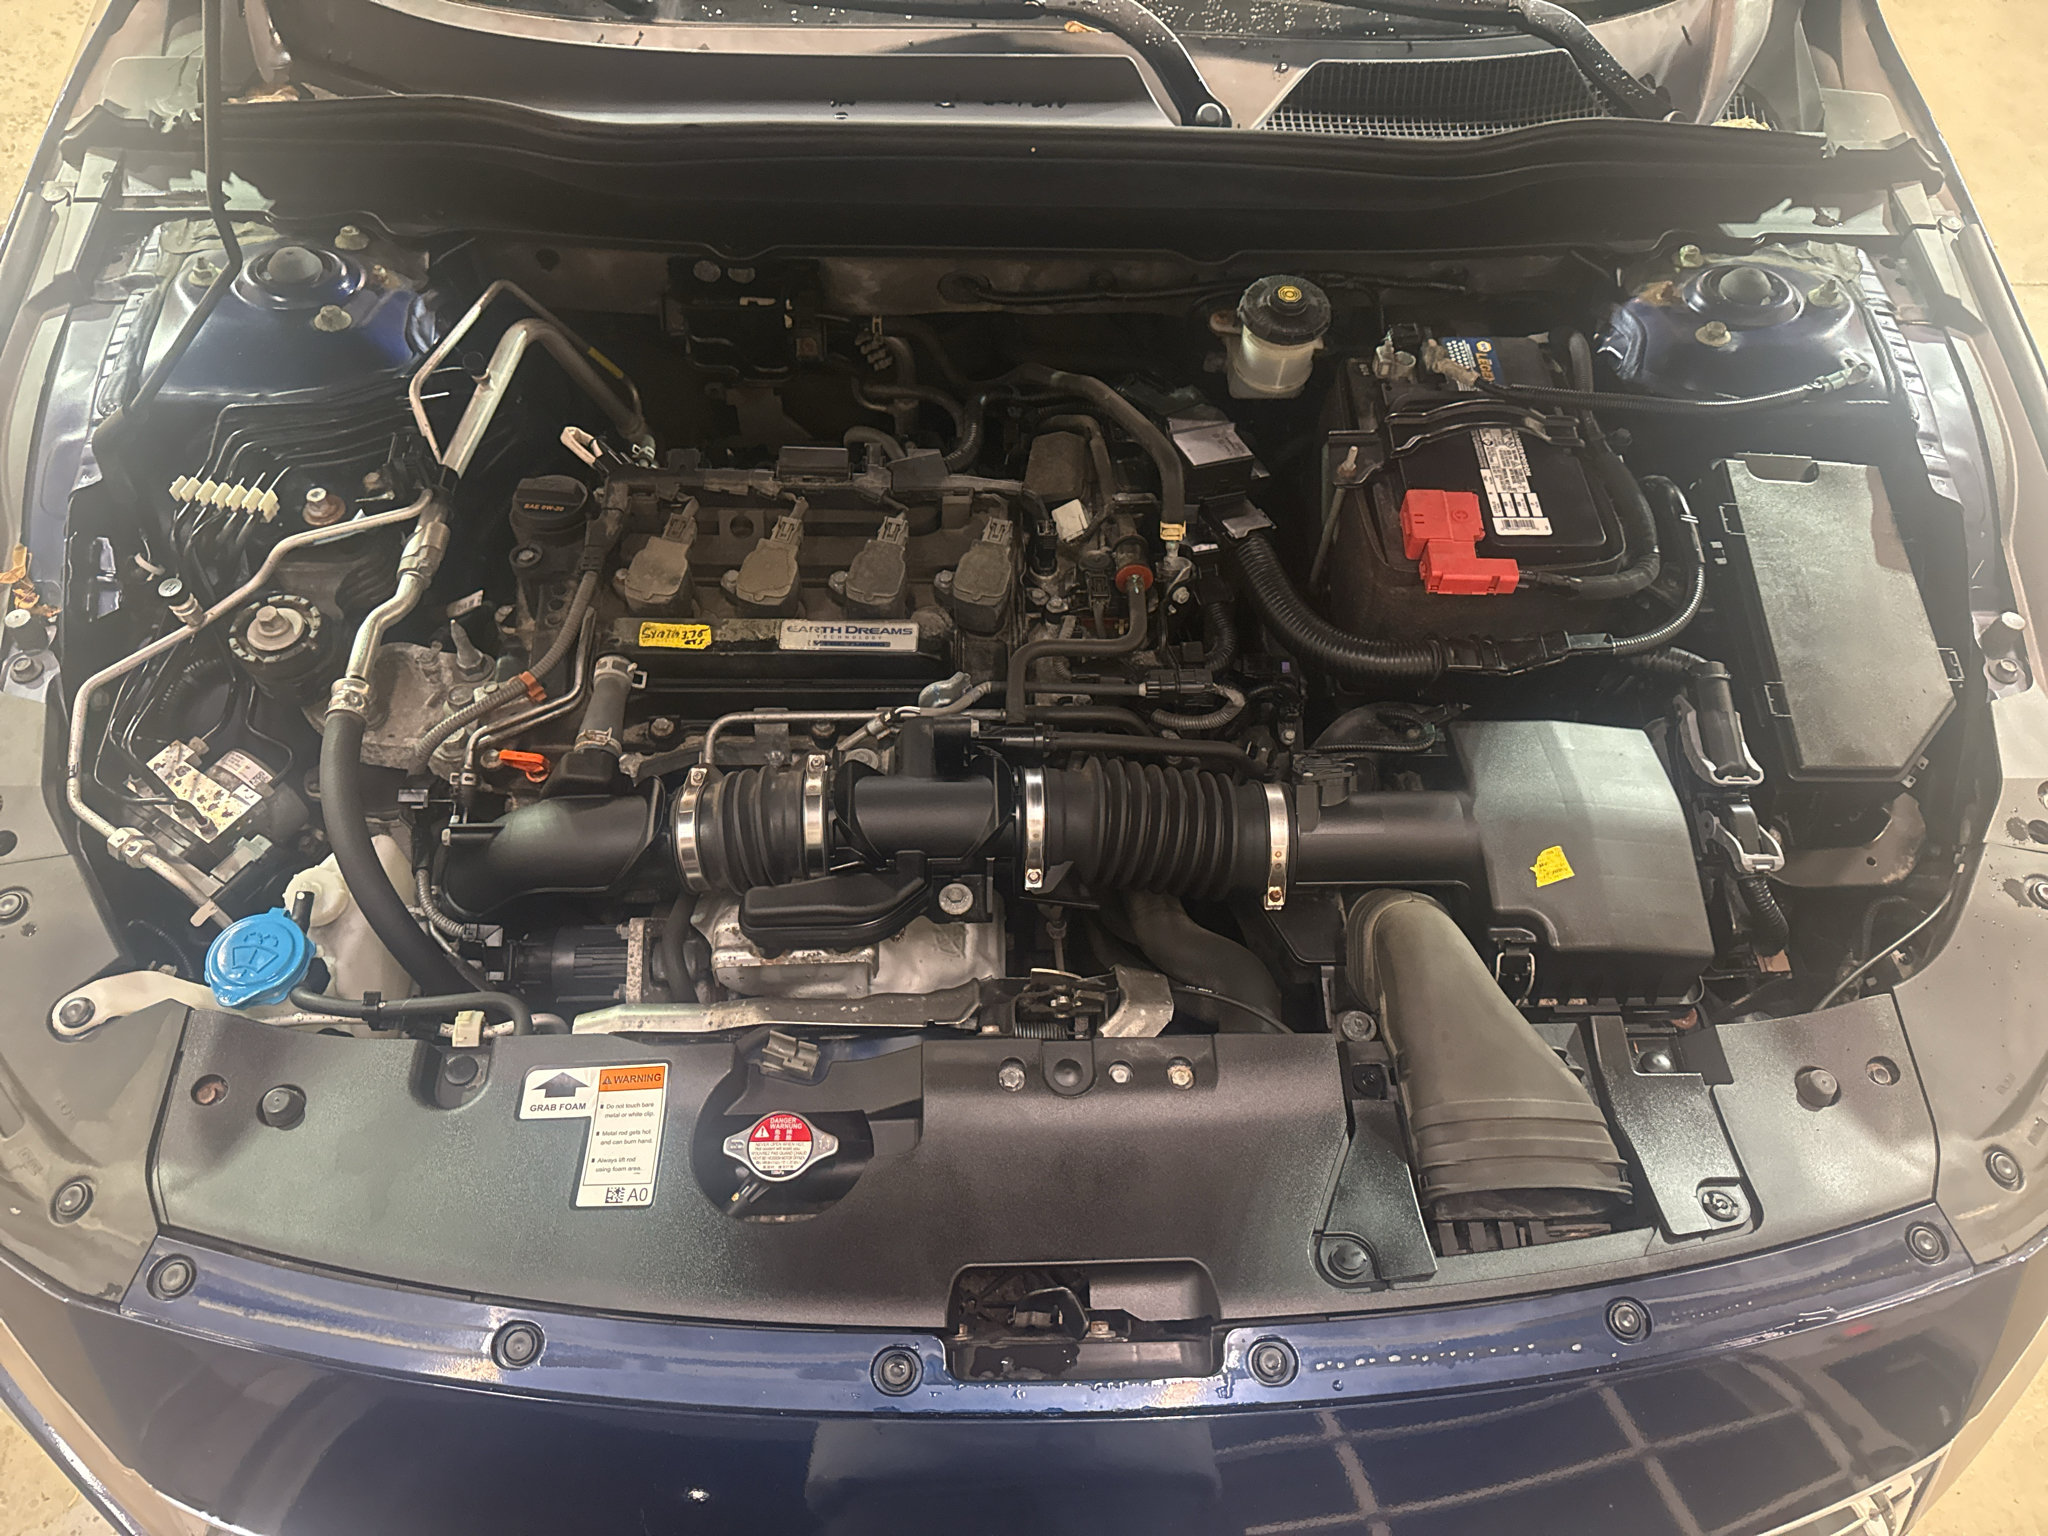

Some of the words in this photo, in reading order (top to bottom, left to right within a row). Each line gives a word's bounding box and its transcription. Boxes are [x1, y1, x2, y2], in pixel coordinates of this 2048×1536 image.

[541, 504, 565, 512] 0W-20
[787, 625, 841, 634] EARTH
[845, 625, 913, 635] DREAMS
[613, 1073, 662, 1084] WARNING
[530, 1103, 557, 1112] GRAB
[559, 1102, 587, 1111] FOAM
[627, 1187, 649, 1202] A0
